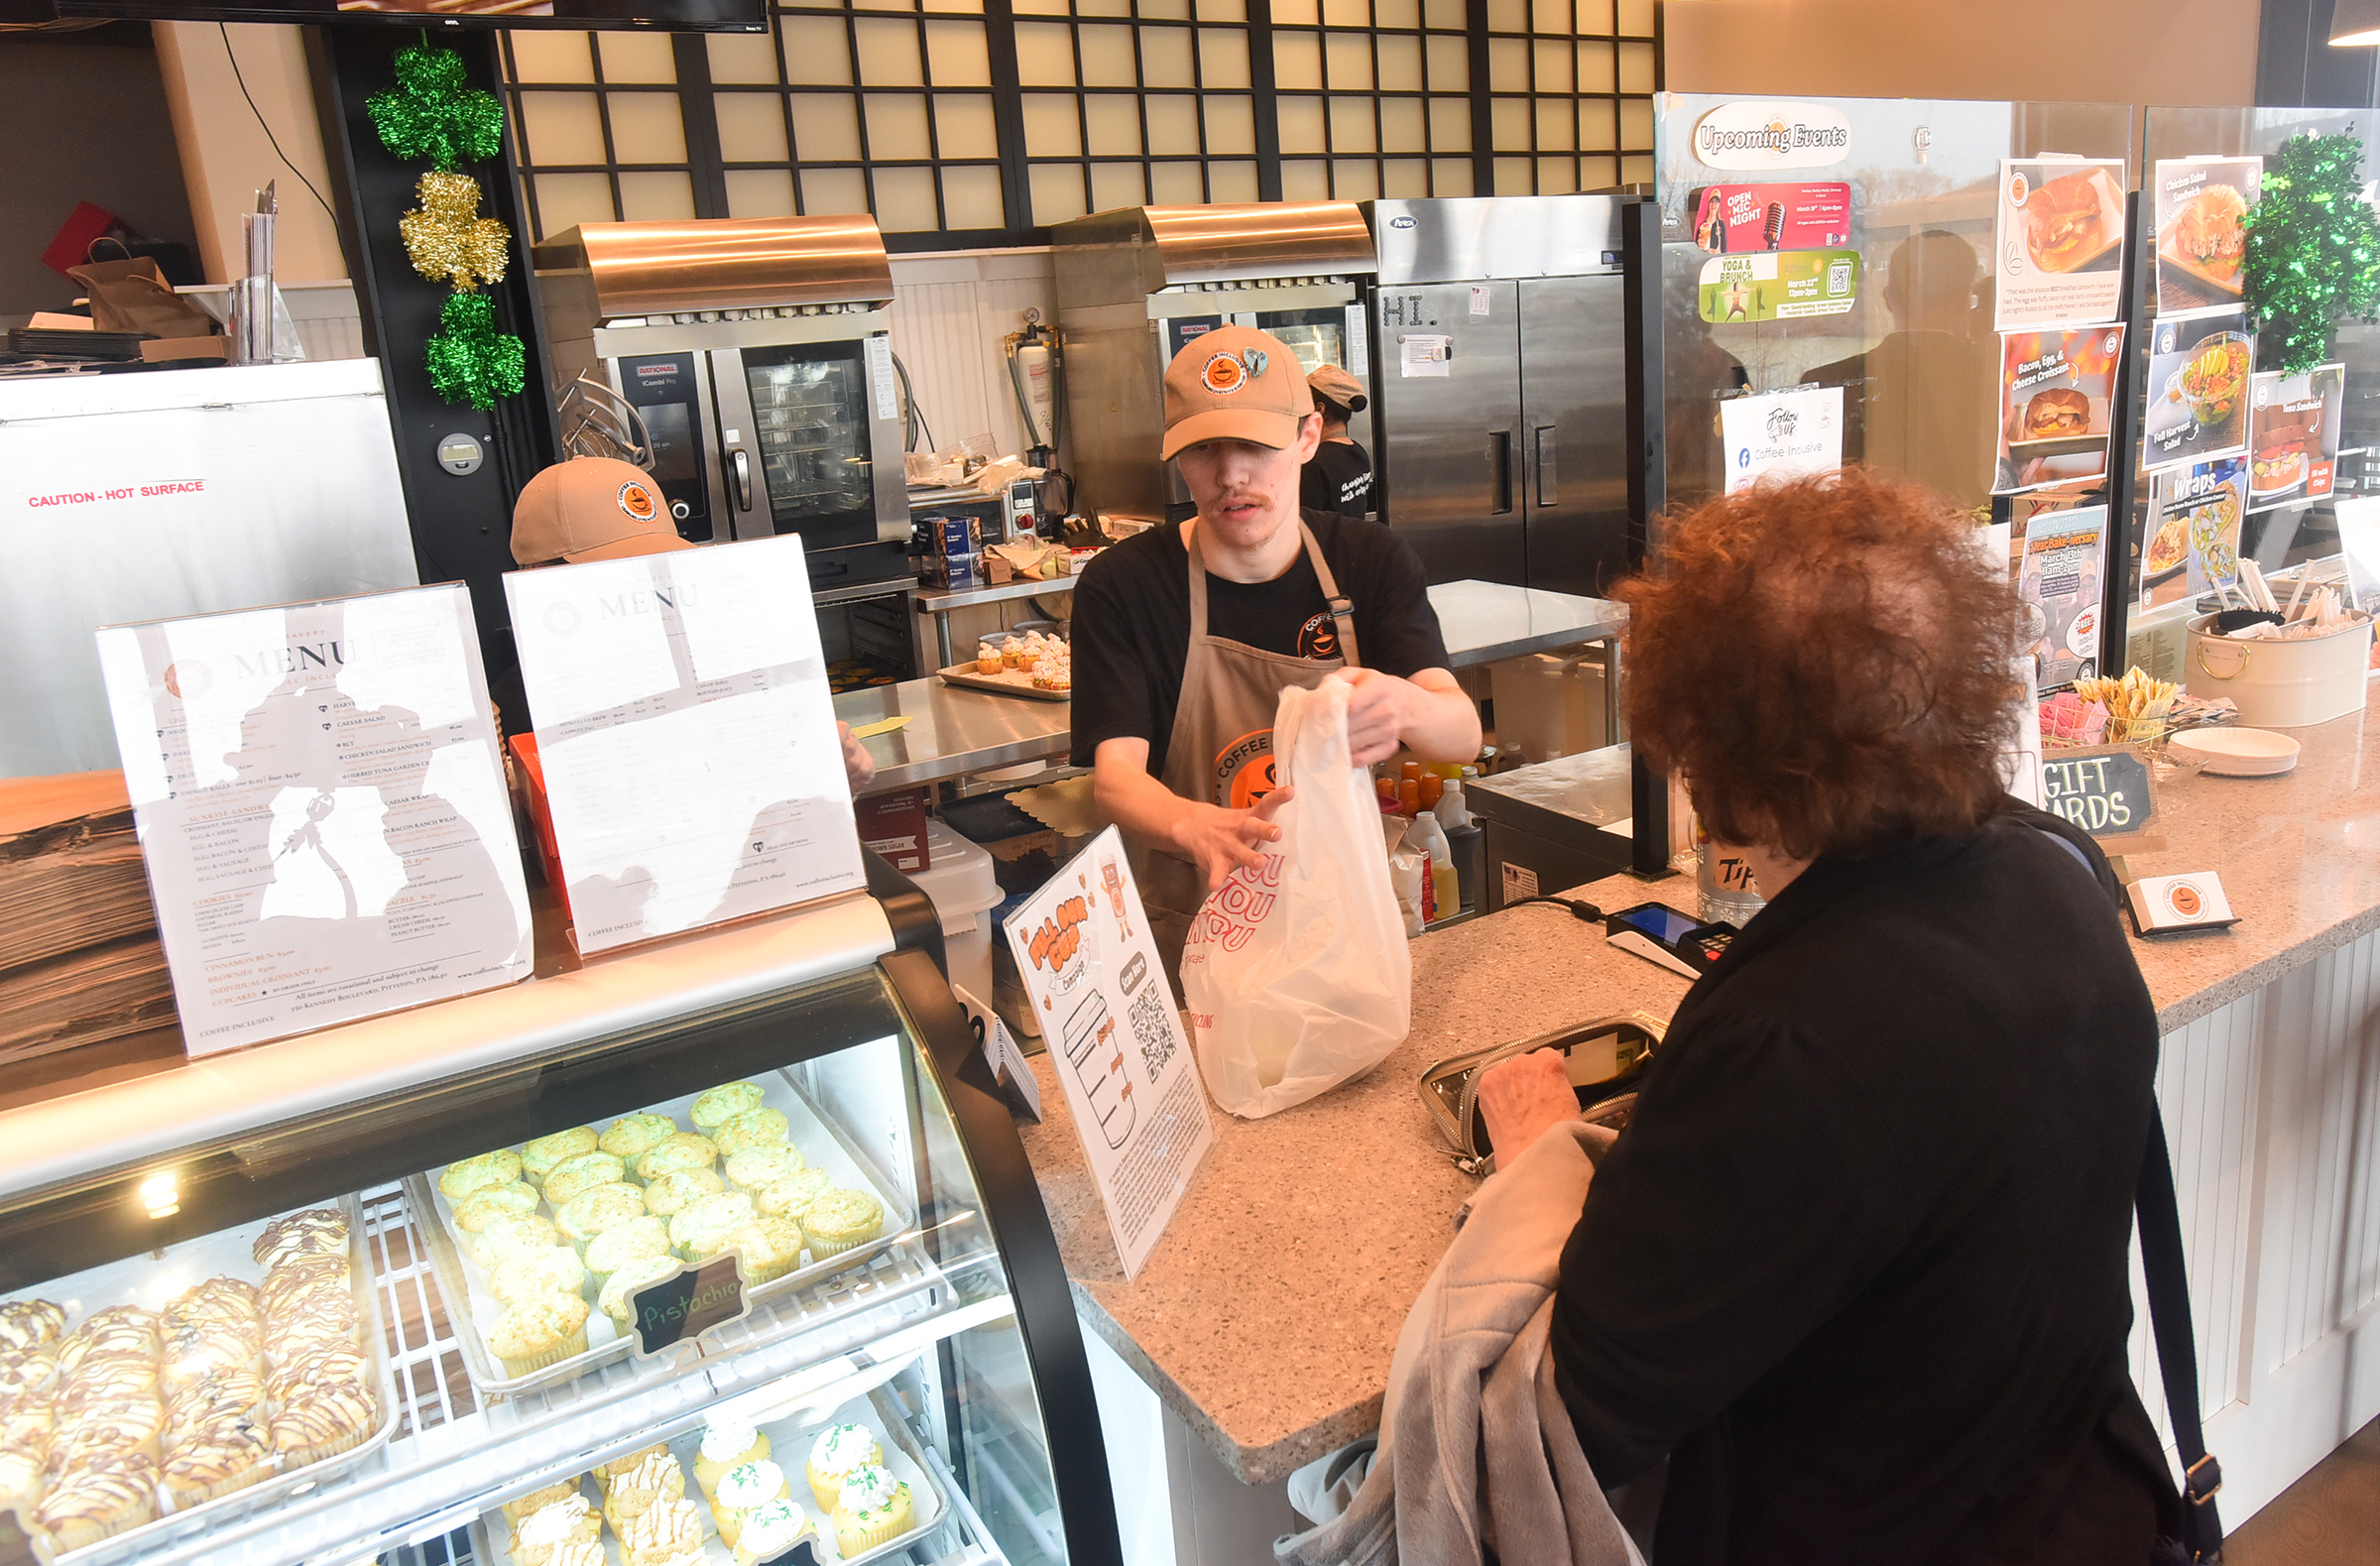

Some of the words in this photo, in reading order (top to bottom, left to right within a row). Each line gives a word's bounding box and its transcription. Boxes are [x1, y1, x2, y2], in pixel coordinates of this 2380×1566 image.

[1701, 125, 1791, 155] Upcoming
[1793, 125, 1846, 147] Events
[2166, 176, 2189, 190] Chicken
[2190, 171, 2206, 183] Salad
[1727, 191, 1751, 206] OPEN
[2173, 186, 2201, 202] Sandwich
[1732, 201, 1750, 215] MIC
[1729, 208, 1761, 227] NIGHT
[1723, 260, 1742, 270] YOGA
[1721, 271, 1753, 283] BRUNCH
[1203, 354, 1218, 372] COFFEE
[1219, 353, 1245, 370] INCLUSIVE
[2018, 360, 2041, 374] Bacon,
[2042, 355, 2057, 367] Egg,
[2058, 350, 2064, 360] &
[2012, 375, 2036, 391] Cheese
[2038, 362, 2070, 382] Croissant
[2283, 404, 2296, 413] Tuna
[2297, 400, 2322, 412] Sandwich
[2154, 430, 2165, 443] Fall
[2167, 421, 2191, 437] Harvest
[1755, 447, 1785, 460] Coffee
[1788, 442, 1823, 456] Inclusive
[2164, 436, 2181, 451] Salad
[29, 492, 95, 507] CAUTION
[105, 488, 134, 500] HOT
[141, 481, 204, 497] SURFACE
[618, 482, 630, 500] COFFEE
[2174, 473, 2216, 500] Wraps
[2035, 540, 2049, 551] Year
[2049, 533, 2098, 549] Bake-iversary
[2040, 551, 2065, 564] March
[2067, 548, 2082, 560] 13th
[2042, 561, 2080, 575] 11am-2pm
[598, 584, 699, 621] MENU
[234, 640, 356, 679] MENU
[337, 719, 363, 728] CAESAR
[364, 715, 385, 724] SALAD
[345, 751, 374, 760] CHICKEN
[375, 747, 397, 756] SALAD
[397, 741, 431, 752] SANDWICH
[1217, 737, 1268, 779] COFFEE
[348, 770, 373, 780] HERBED
[394, 762, 419, 771] GARDEN
[2043, 757, 2111, 798] GIFT
[385, 797, 410, 806] CAESAR
[2045, 791, 2131, 830] ARDS
[188, 811, 227, 822] SUNRISE
[212, 828, 238, 837] CHEESE
[391, 824, 414, 833] BACON
[214, 838, 240, 847] BACON
[218, 857, 250, 868] SAUSAGE
[216, 869, 247, 879] SAUSAGE
[1719, 858, 1758, 890] Tip
[2166, 884, 2176, 899] COFFEE
[2177, 882, 2202, 895] INCLUSIVE
[192, 895, 231, 906] COOKIES
[588, 925, 613, 937] COFFEE
[1028, 916, 1059, 971] FILL
[1056, 896, 1088, 931] OUR
[1048, 924, 1080, 973] CUP
[205, 958, 254, 971] CINNAMON
[256, 953, 274, 962] BUN
[278, 949, 295, 958] $3.00
[207, 969, 253, 983] BROWNIES
[210, 981, 262, 995] INDIVIDUAL
[263, 968, 310, 984] CROISSANT
[314, 965, 331, 974] $3.00
[306, 990, 325, 999] items
[339, 978, 371, 993] rotational
[372, 975, 385, 984] and
[385, 970, 409, 981] subject
[417, 964, 440, 975] change
[1063, 959, 1085, 991] Campaign
[1121, 973, 1134, 994] Scan
[212, 992, 257, 1007] CUPCAKES
[303, 997, 336, 1009] KENNEDY
[200, 1024, 231, 1037] COFFEE
[232, 1016, 275, 1029] INCLUSIVE
[644, 1282, 738, 1331] Pistachio
